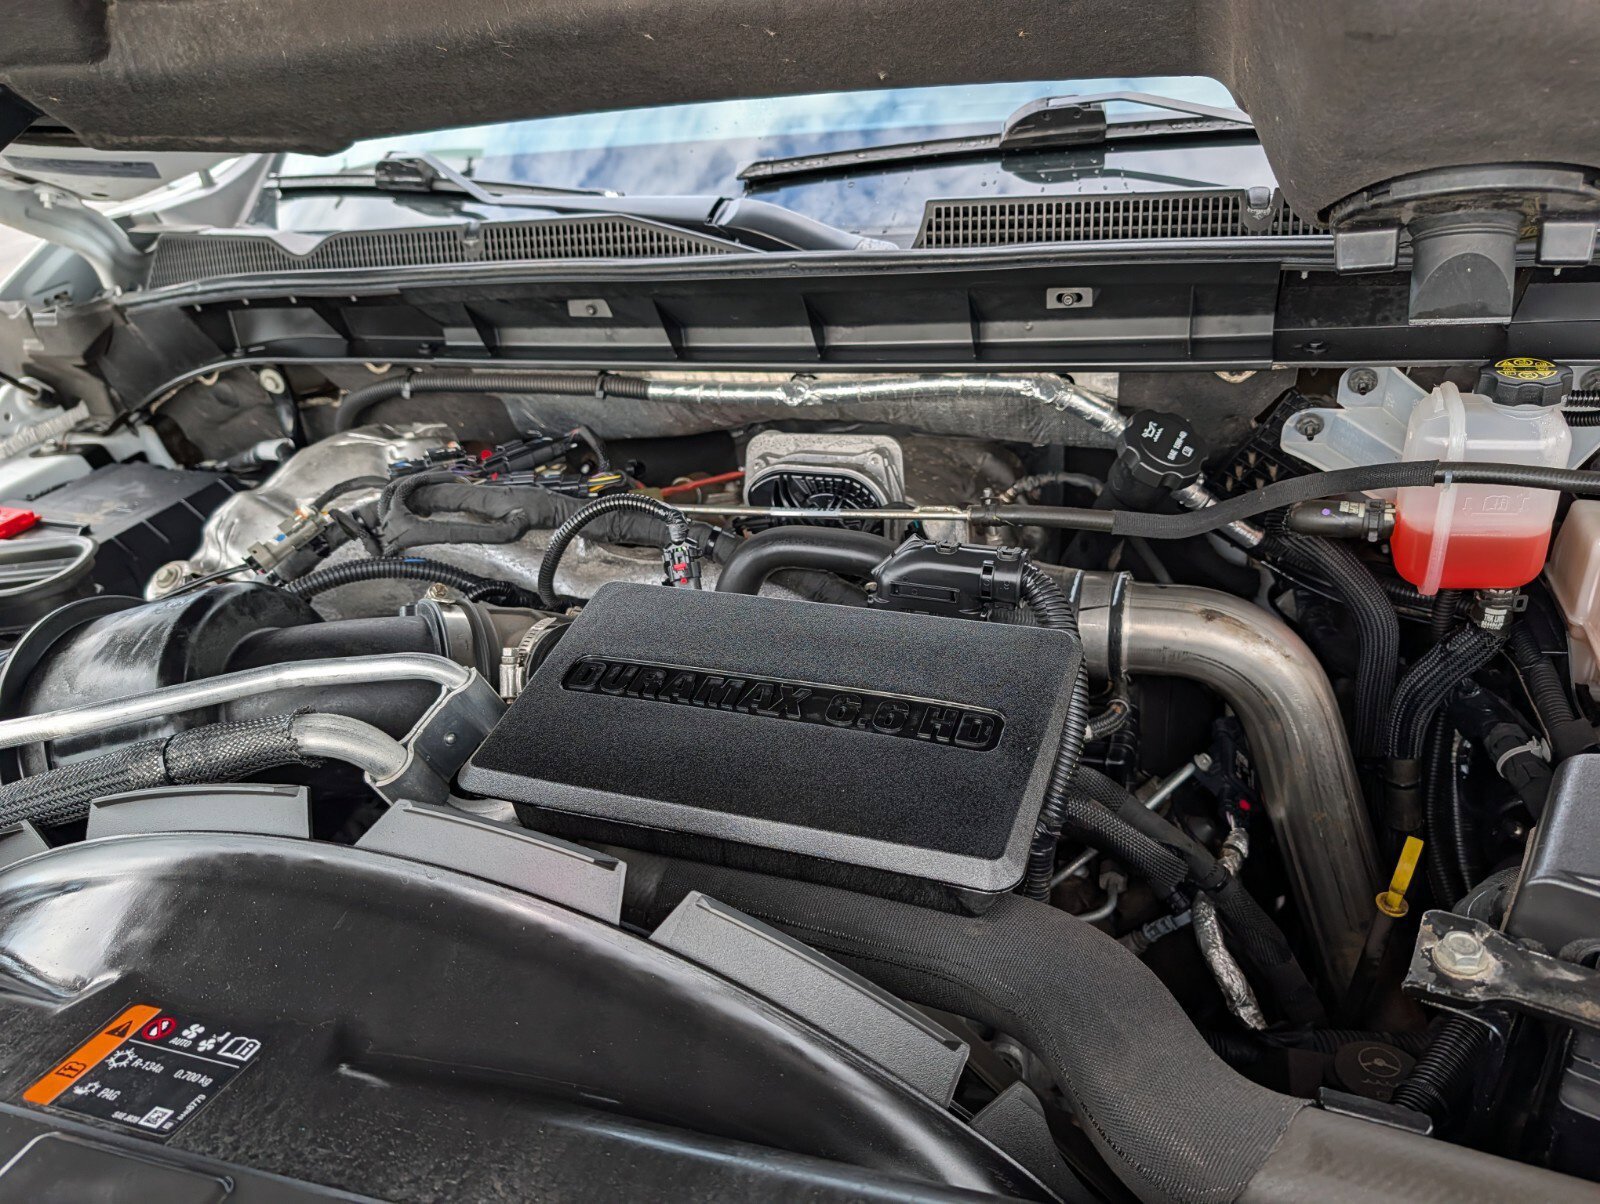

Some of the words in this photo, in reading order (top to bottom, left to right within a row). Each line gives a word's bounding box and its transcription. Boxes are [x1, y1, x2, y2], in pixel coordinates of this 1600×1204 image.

[568, 660, 812, 720] DURAMAX
[825, 693, 910, 734] 6.6
[916, 706, 996, 748] HD
[168, 1036, 193, 1048] AUTO
[131, 1058, 164, 1074] R-134a
[173, 1069, 201, 1083] 0.700
[198, 1074, 213, 1088] kg
[96, 1087, 121, 1101] PAG
